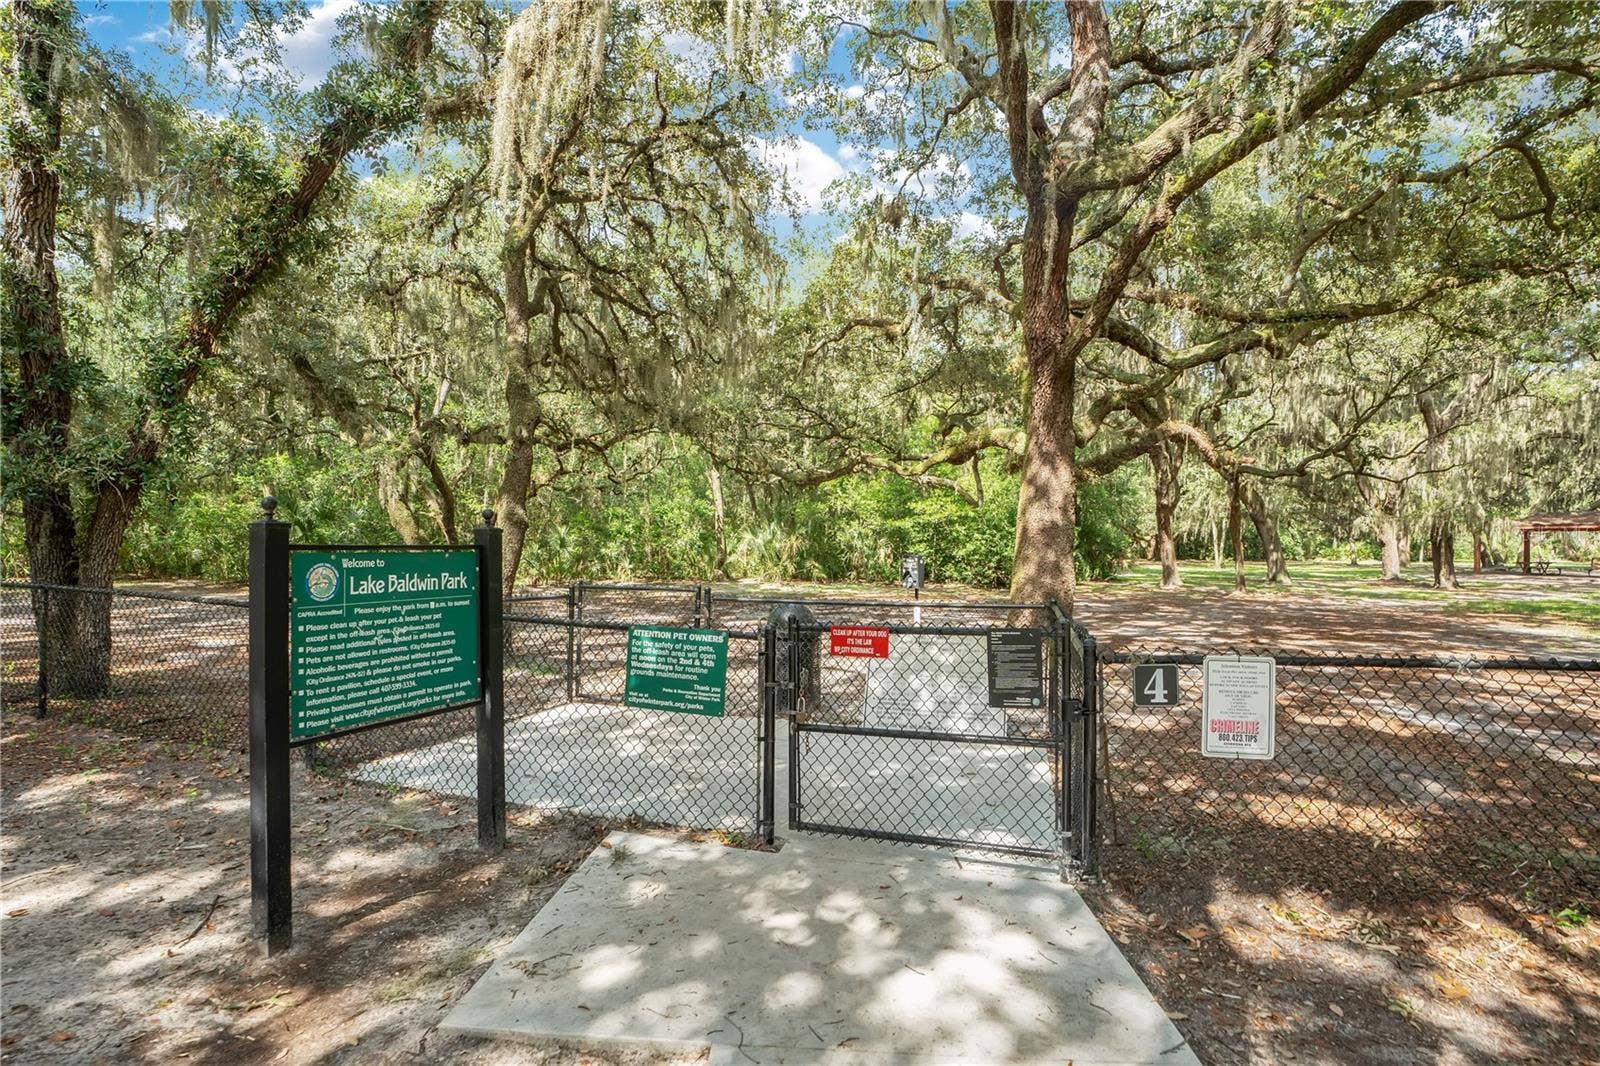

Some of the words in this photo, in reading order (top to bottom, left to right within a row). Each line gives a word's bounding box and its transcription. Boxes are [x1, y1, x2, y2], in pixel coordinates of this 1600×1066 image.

[342, 558, 375, 568] Welcome
[376, 559, 384, 567] to
[350, 574, 385, 594] Lake
[388, 573, 438, 592] Baldwin
[441, 572, 468, 590] Park
[403, 604, 416, 612] park
[306, 624, 328, 632] Please
[330, 622, 348, 630] clean
[359, 619, 372, 628] after
[306, 634, 328, 642] except
[337, 632, 348, 640] the
[633, 630, 671, 639] ATTENTION
[689, 634, 724, 643] OWNERS
[306, 646, 328, 654] Please
[330, 642, 345, 650] read
[346, 638, 377, 649] additional
[306, 656, 320, 664] Pets
[347, 650, 370, 659] allowed
[379, 646, 408, 654] restrooms.
[306, 666, 336, 675] Alcoholic
[338, 661, 368, 671] beverages
[382, 654, 410, 666] prohibited
[411, 651, 430, 660] without
[373, 666, 392, 675] please
[412, 660, 430, 668] smoke
[631, 661, 673, 671] Wednesdays
[316, 687, 330, 695] rent
[337, 682, 362, 692] pavilion,
[363, 676, 390, 686] schedule
[396, 672, 416, 680] special
[417, 670, 433, 678] event,
[656, 671, 699, 680] maintenance.
[1144, 668, 1168, 702] 4
[306, 708, 330, 718] Private
[332, 701, 366, 712] businesses
[367, 697, 382, 706] must
[384, 694, 402, 702] obtain
[408, 688, 426, 698] permit
[434, 684, 453, 692] operate
[460, 680, 472, 688] park.
[348, 690, 368, 700] please
[629, 696, 704, 710] cityofwinterpark.org/parks
[306, 719, 330, 728] Please
[331, 714, 344, 723] visit
[1210, 719, 1260, 735] CRIMELINE
